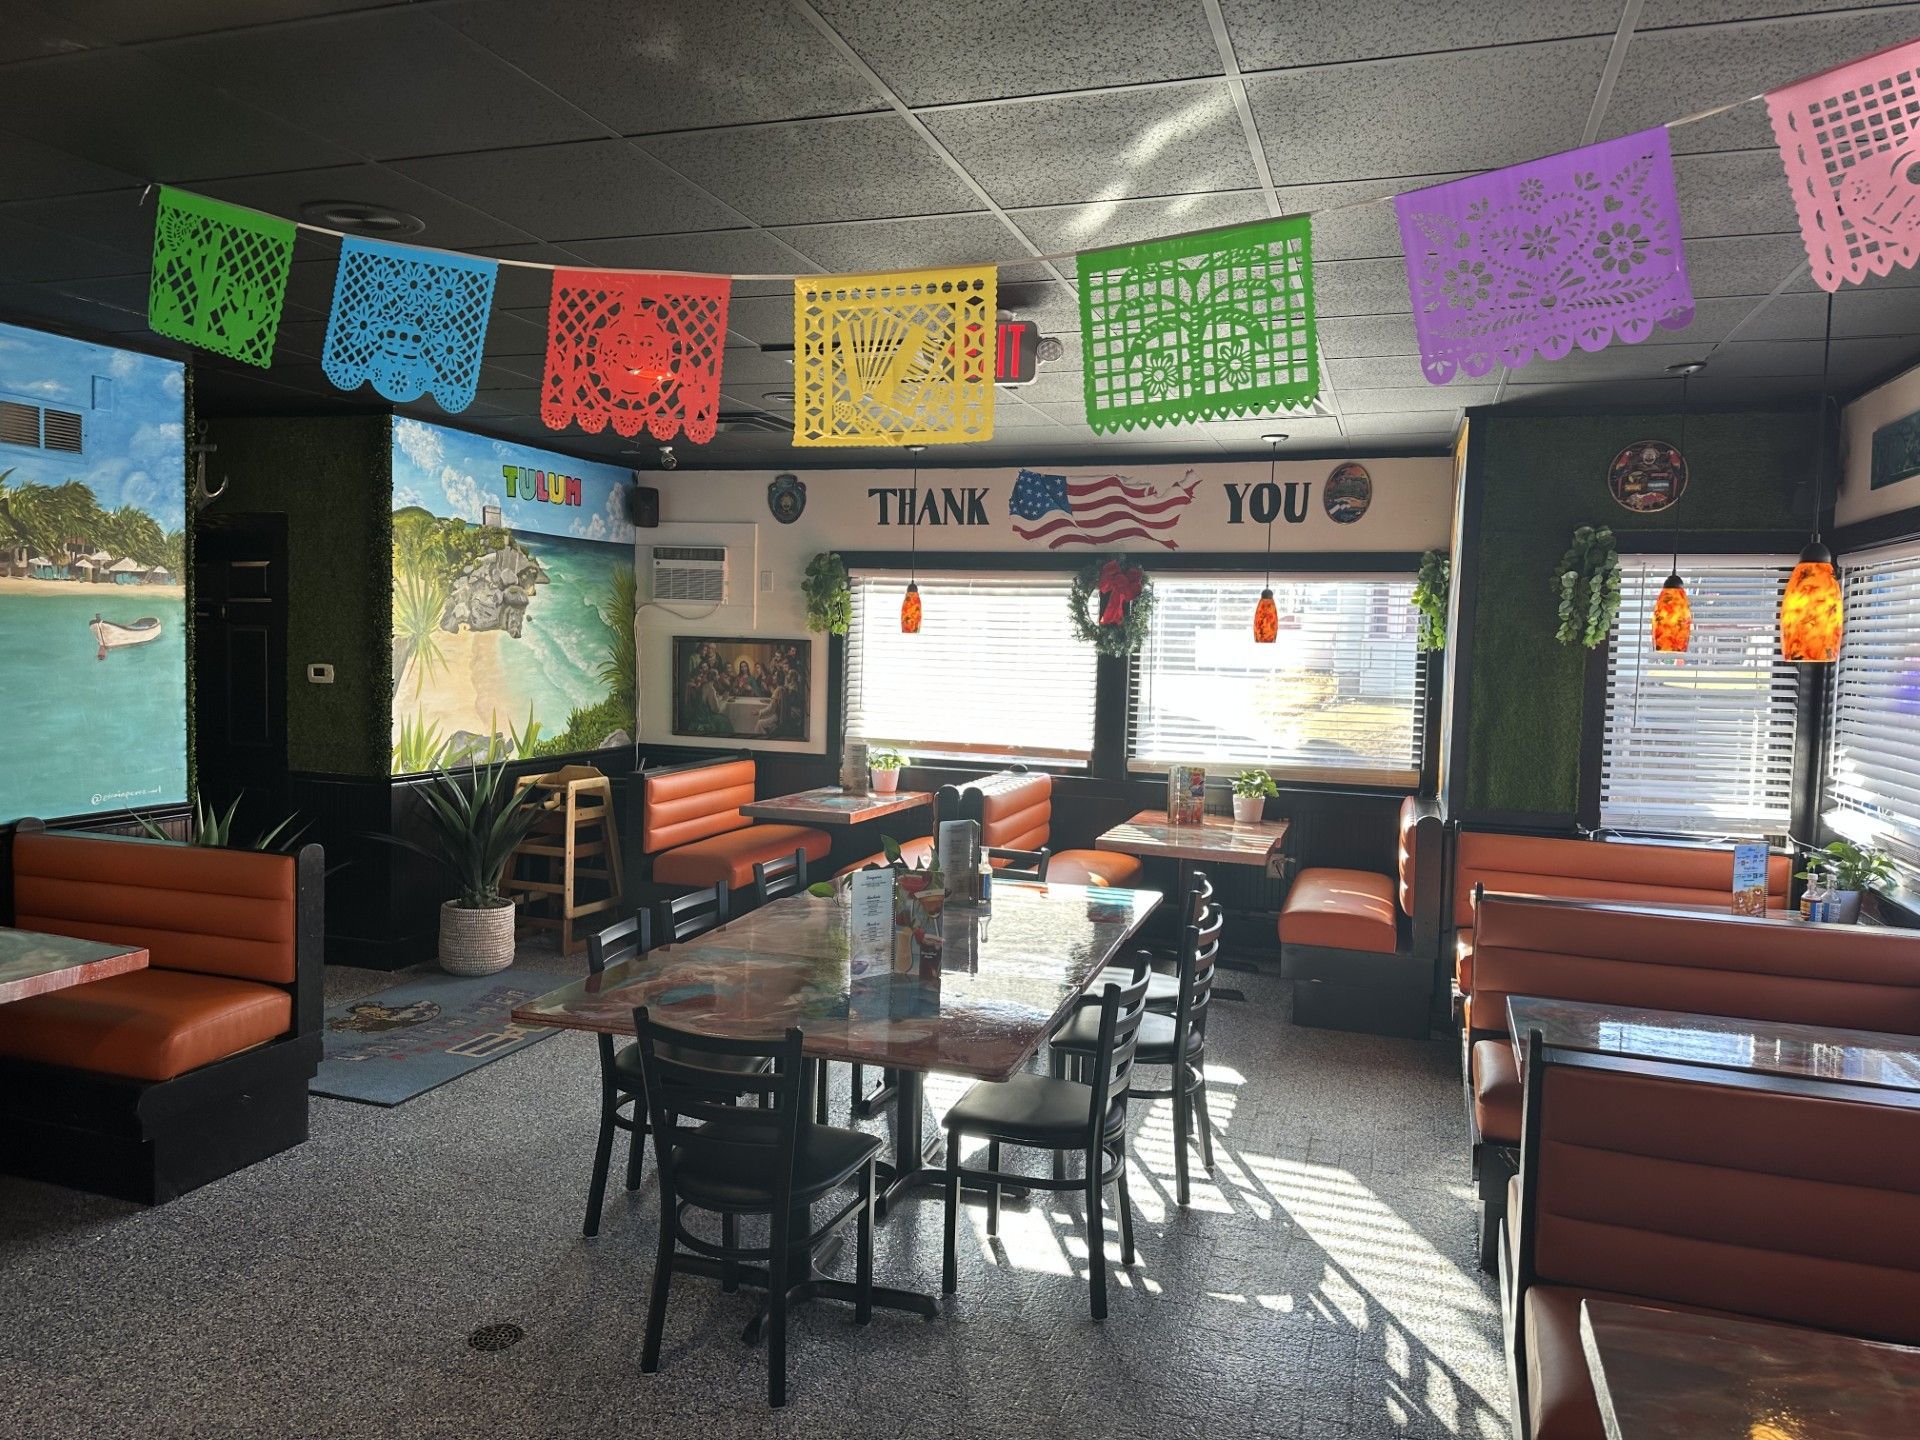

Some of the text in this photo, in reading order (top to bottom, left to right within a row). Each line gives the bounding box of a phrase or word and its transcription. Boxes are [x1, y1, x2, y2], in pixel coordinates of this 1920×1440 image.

[503, 465, 582, 506] TULUM
[868, 482, 1312, 525] THANK YOU
